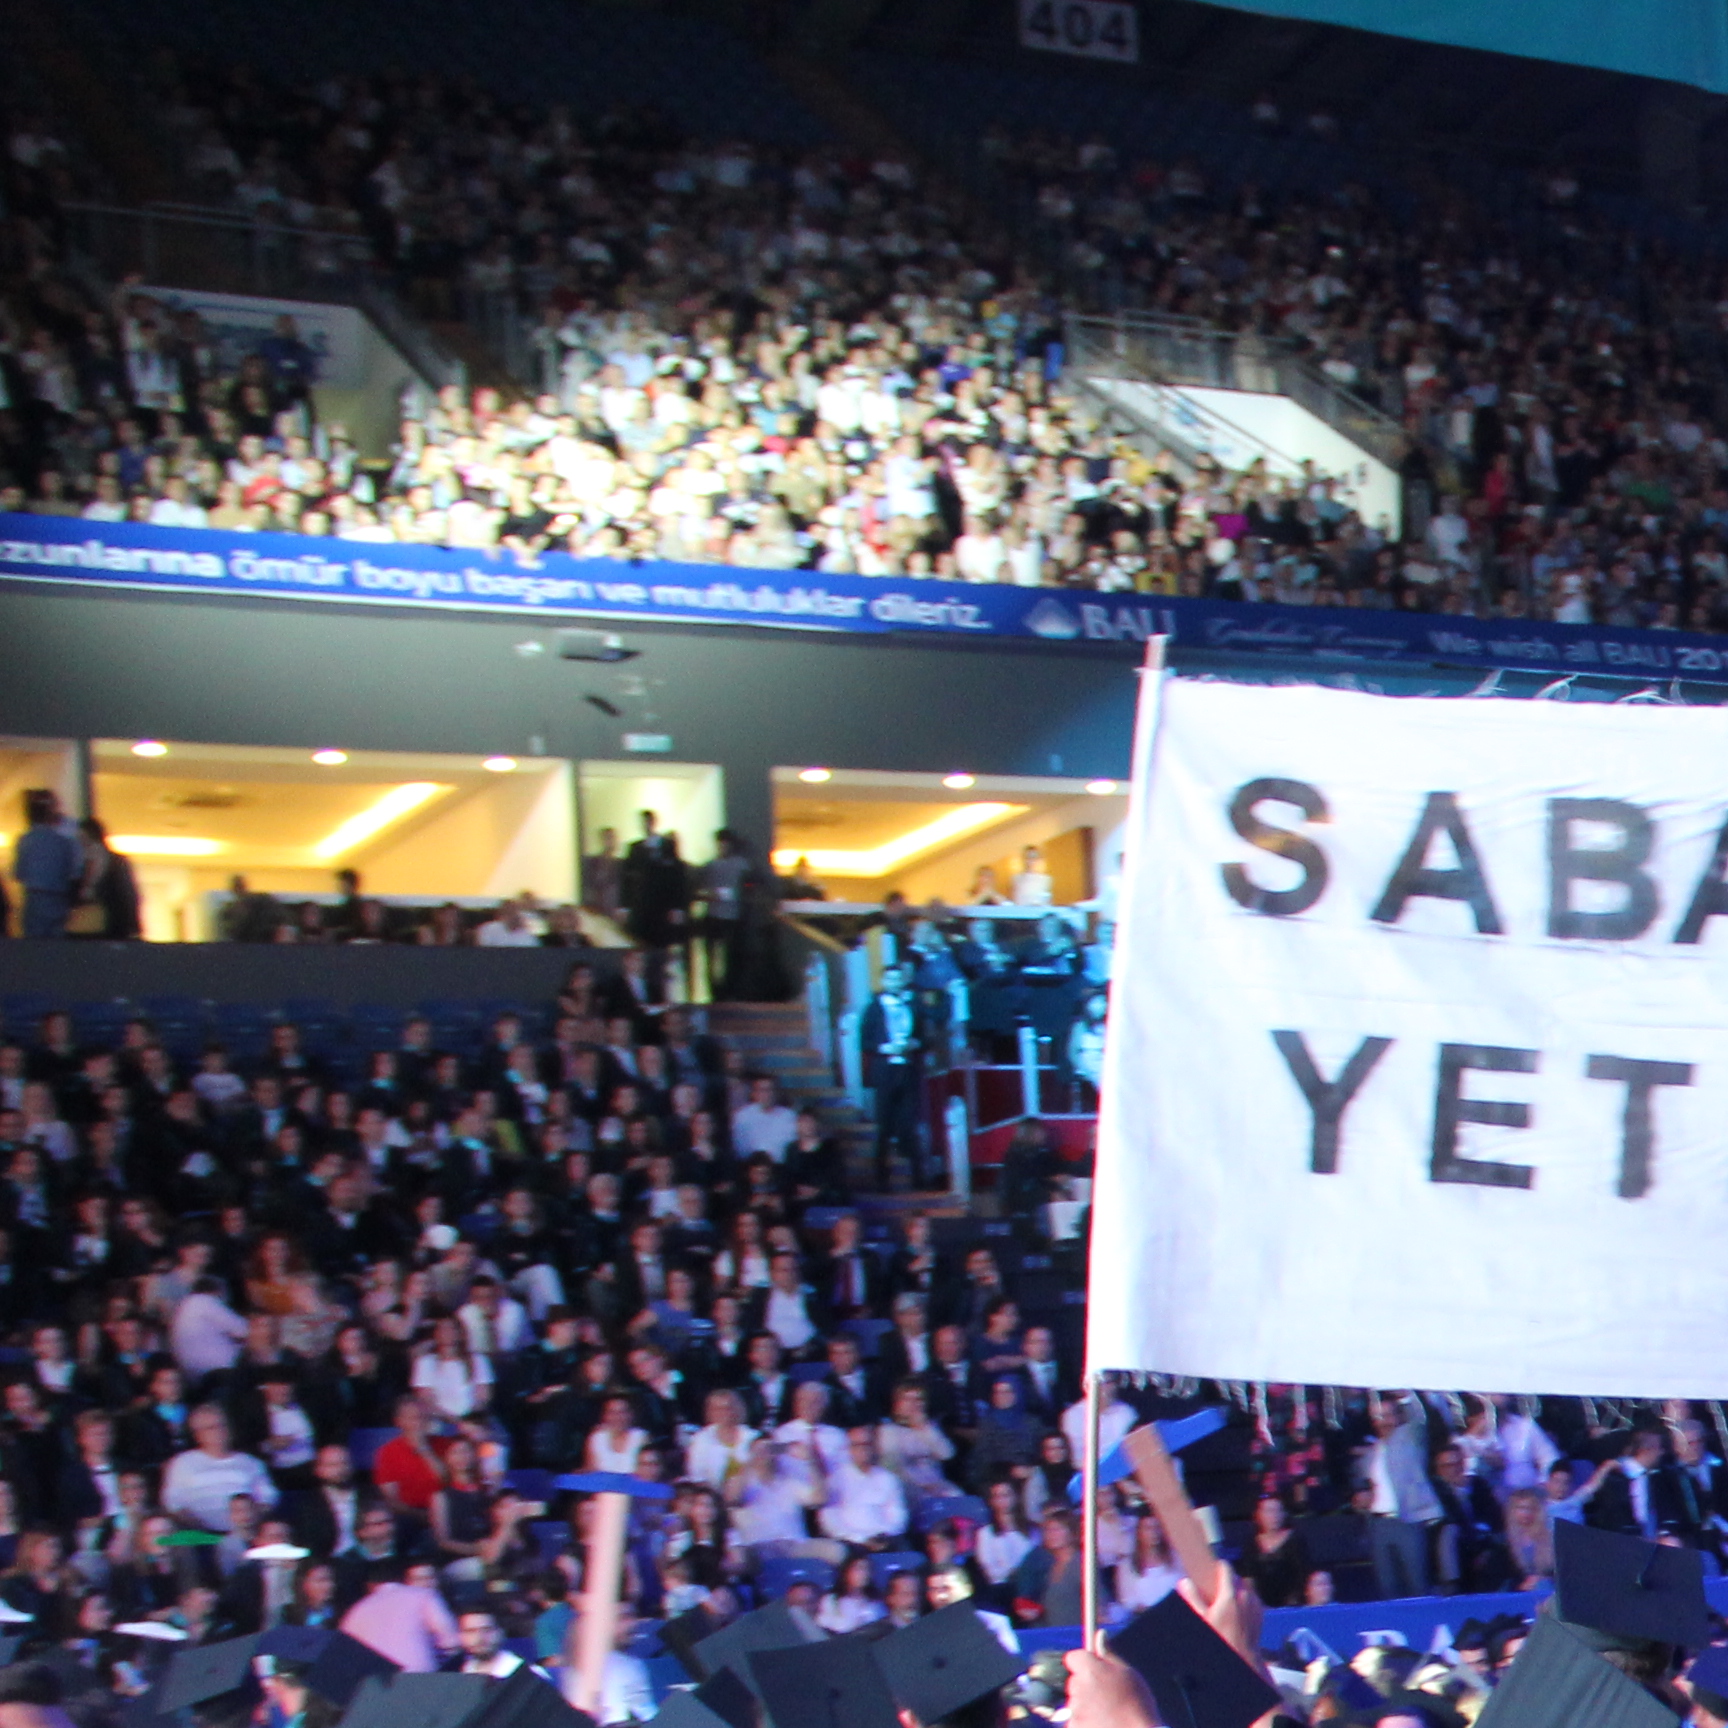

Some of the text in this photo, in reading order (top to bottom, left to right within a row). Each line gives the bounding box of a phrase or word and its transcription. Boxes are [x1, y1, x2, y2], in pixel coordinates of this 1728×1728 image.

[1029, 0, 1128, 52] 404
[0, 538, 227, 579] zunlarına
[229, 549, 352, 588] ömür
[353, 558, 464, 599] boyu
[600, 580, 647, 606] ve
[1080, 602, 1178, 644] BAU
